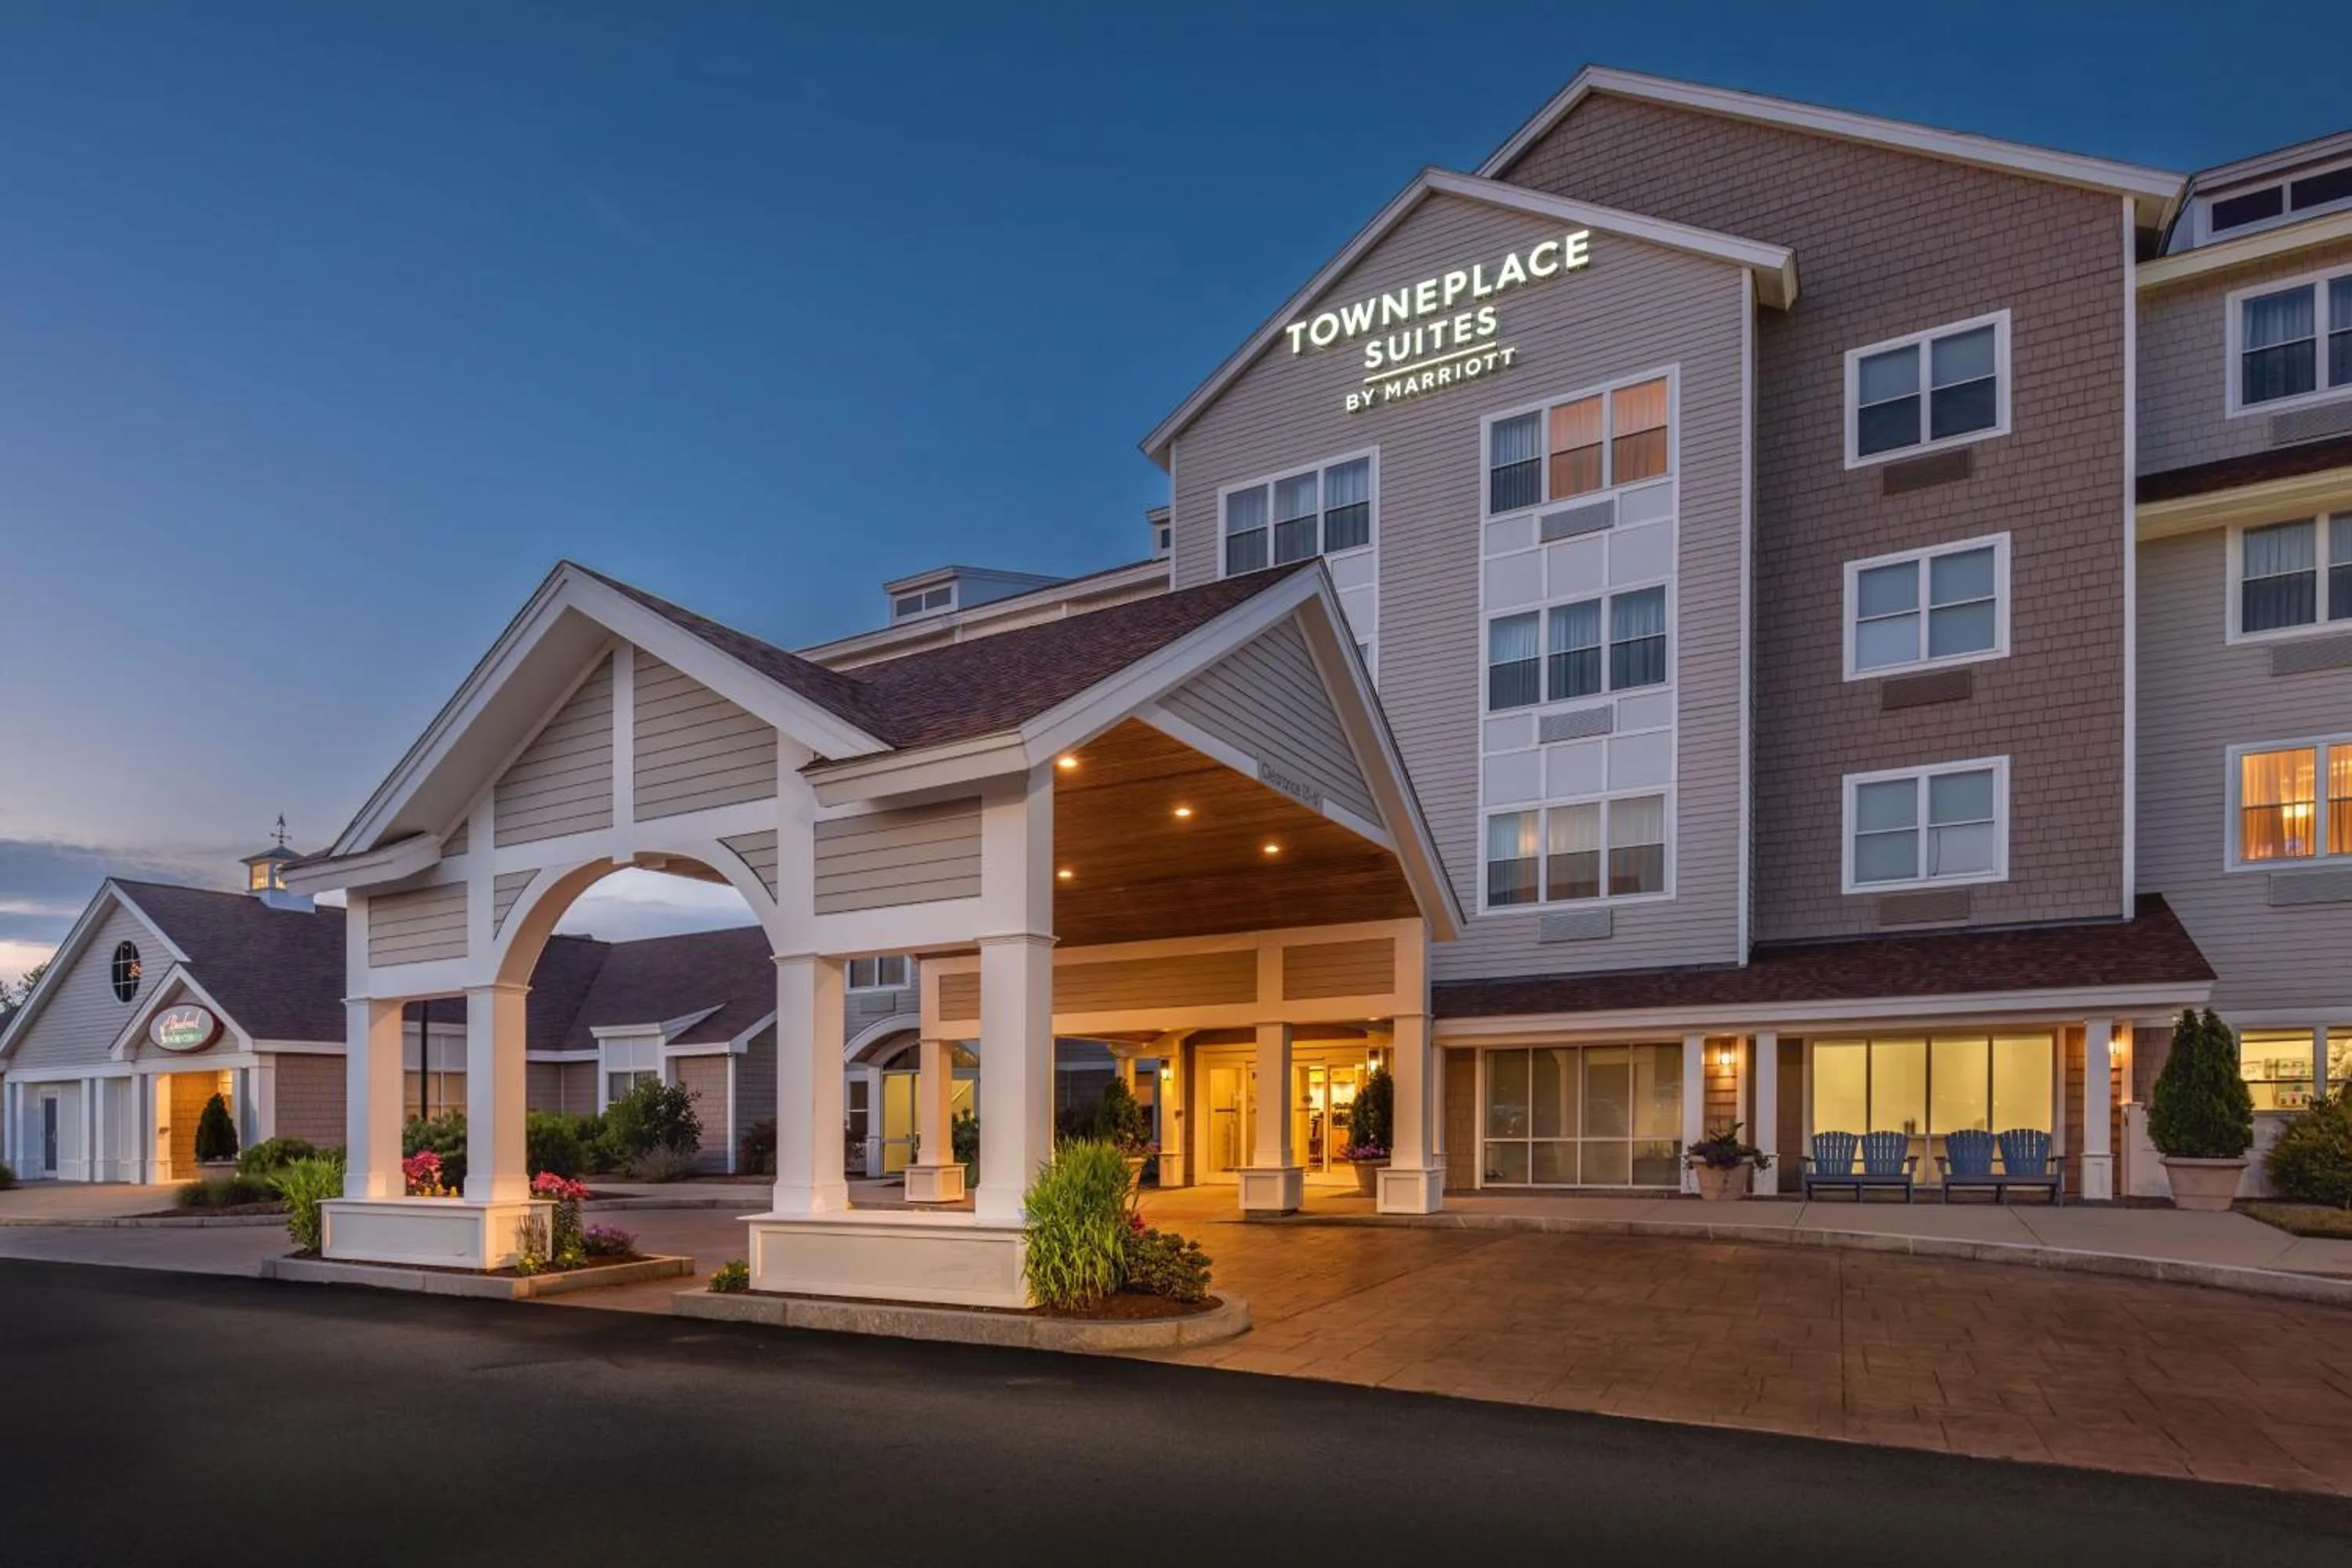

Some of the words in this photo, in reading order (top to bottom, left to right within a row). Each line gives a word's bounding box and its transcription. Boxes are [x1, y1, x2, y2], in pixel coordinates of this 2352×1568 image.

[1285, 229, 1590, 354] TOWNEPLACE
[1363, 306, 1497, 369] SUITES
[1345, 387, 1376, 413] BY
[1385, 347, 1515, 401] MARRIOTT
